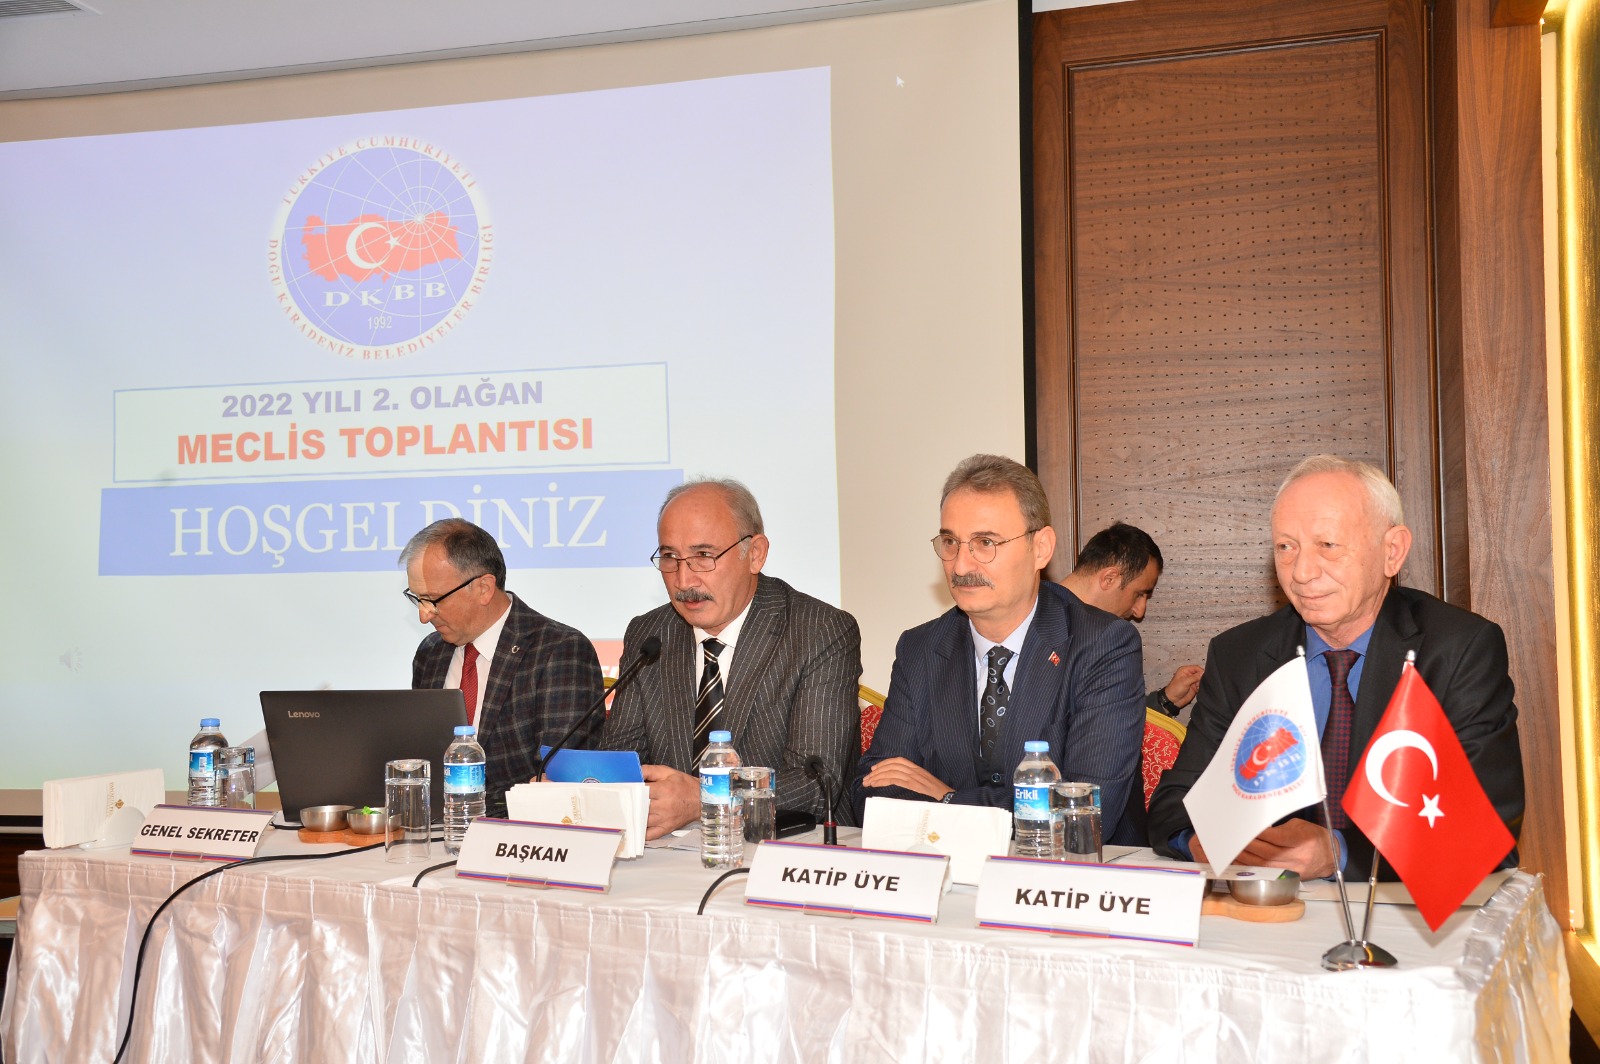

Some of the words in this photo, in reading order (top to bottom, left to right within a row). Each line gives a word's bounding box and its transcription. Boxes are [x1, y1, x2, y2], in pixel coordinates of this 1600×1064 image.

[367, 315, 393, 330] 1992
[221, 392, 293, 418] 2022
[302, 390, 361, 414] YILI
[373, 388, 399, 411] 2.
[410, 377, 543, 410] OLAĞAN
[178, 422, 326, 465] MECLİS
[339, 418, 593, 459] TOPLANTISI
[287, 710, 321, 718] Lenovo
[1015, 788, 1039, 800] Erikli
[140, 824, 183, 838] GENEL
[186, 827, 259, 843] SEKRETER
[495, 842, 569, 863] BAŞKAN
[781, 866, 847, 886] KATİP
[854, 870, 901, 892] ÜYE
[1015, 887, 1090, 910] KATİP
[1098, 891, 1151, 915] ÜYE
